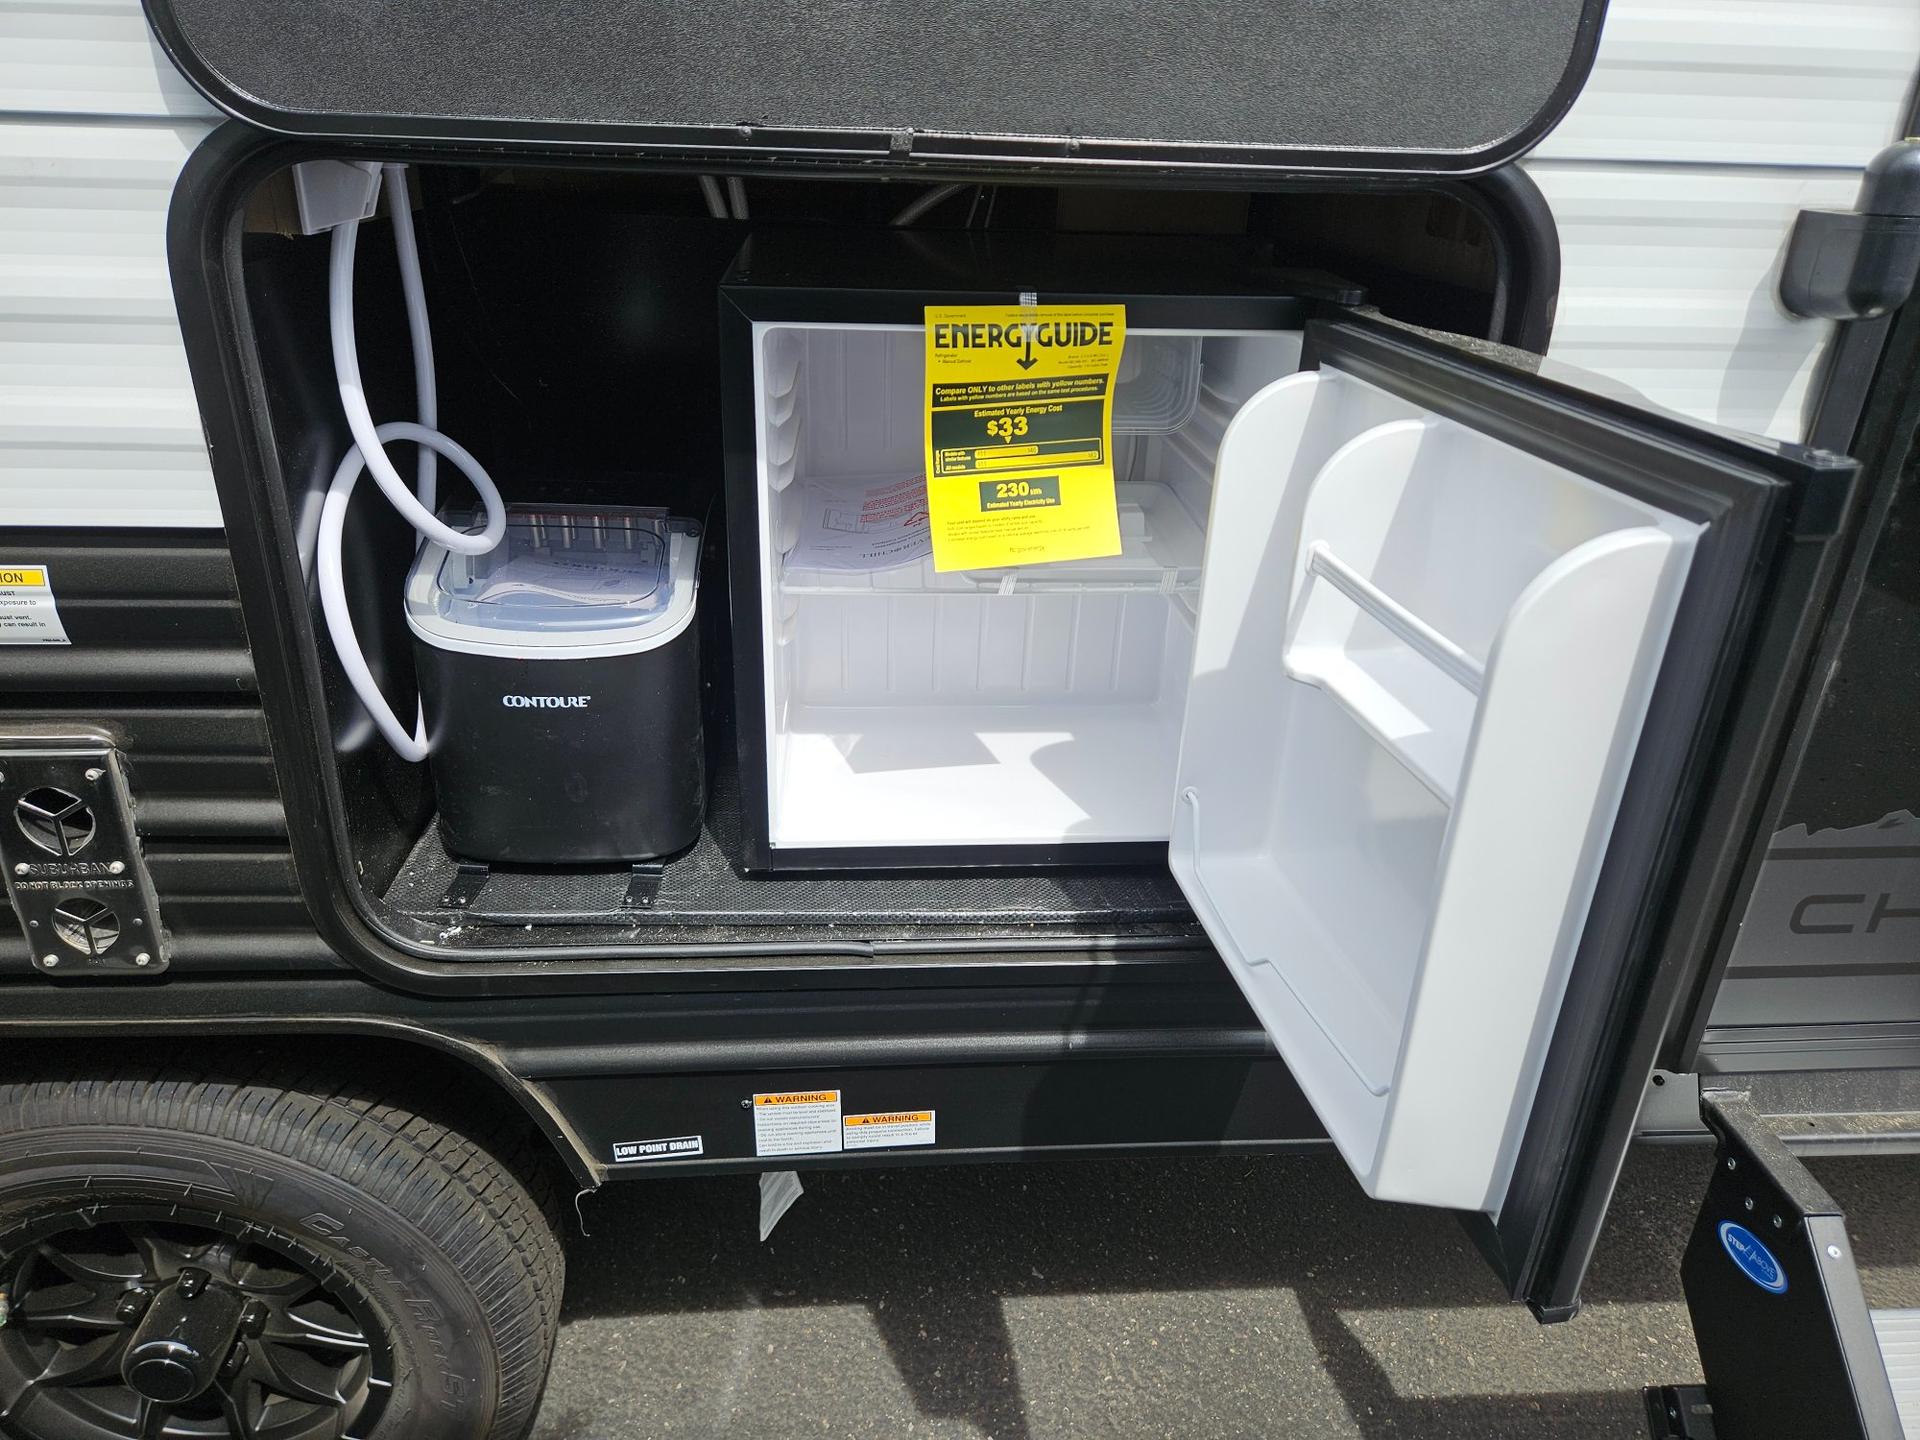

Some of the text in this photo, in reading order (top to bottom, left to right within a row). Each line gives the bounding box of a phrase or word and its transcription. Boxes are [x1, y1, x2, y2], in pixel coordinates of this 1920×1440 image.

[935, 387, 967, 396] Compare
[967, 385, 988, 394] ONLY
[996, 384, 1015, 392] other
[1015, 382, 1036, 390] labels
[1051, 380, 1074, 389] yellow
[974, 404, 1063, 418] Estimated Yearly Energy Cost
[987, 416, 1029, 437] $33
[996, 481, 1030, 498] 230
[502, 695, 589, 709] CONTOURE
[29, 861, 111, 877] SUBURBAN
[29, 881, 49, 890] NOT
[50, 880, 84, 889] BLOCK
[84, 879, 135, 889] OPENINGS
[775, 1093, 827, 1103] WARNING
[872, 1114, 919, 1123] WARNING
[616, 1140, 699, 1156] LOW POINT DRAIN
